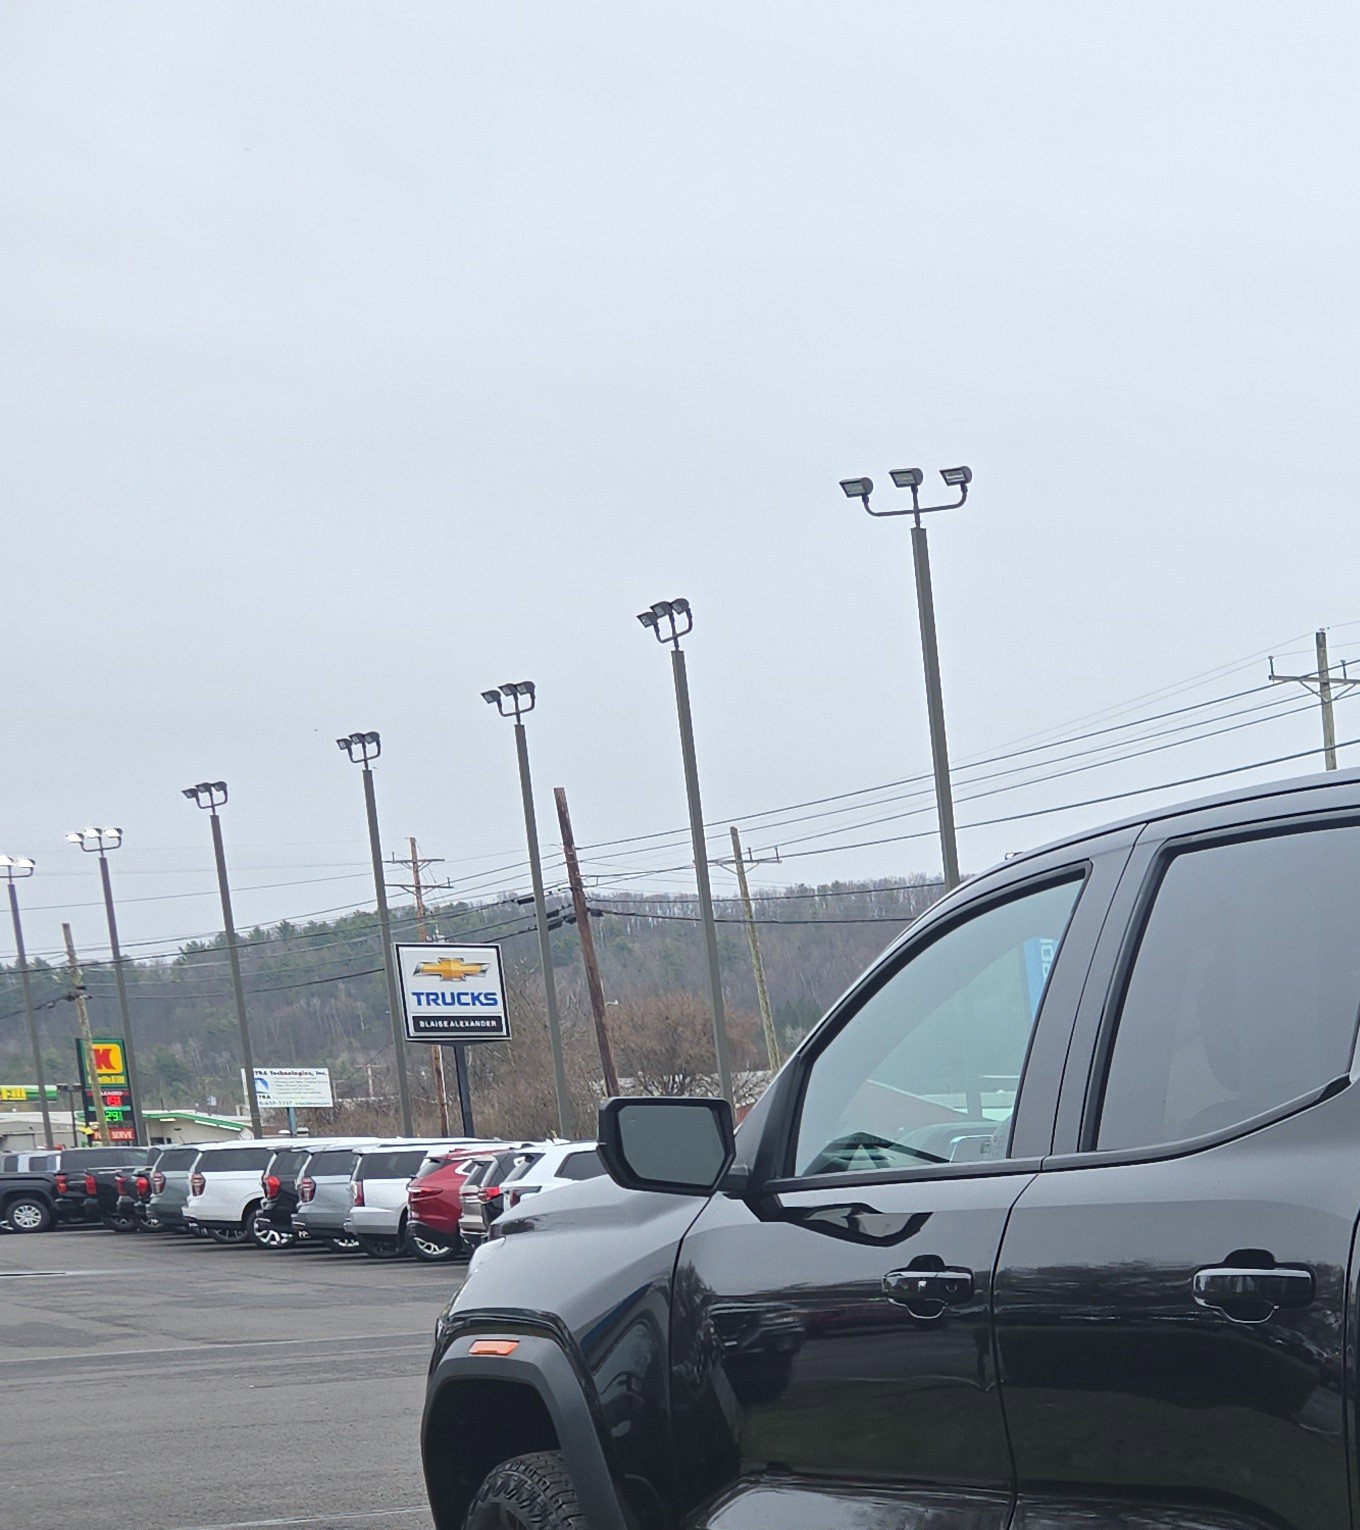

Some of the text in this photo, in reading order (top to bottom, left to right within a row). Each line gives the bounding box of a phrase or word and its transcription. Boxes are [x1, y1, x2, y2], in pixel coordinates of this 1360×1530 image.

[411, 991, 498, 1007] TRUCKS
[419, 1020, 497, 1028] BLAISE ALEXANDER
[111, 1130, 134, 1140] SERVE
